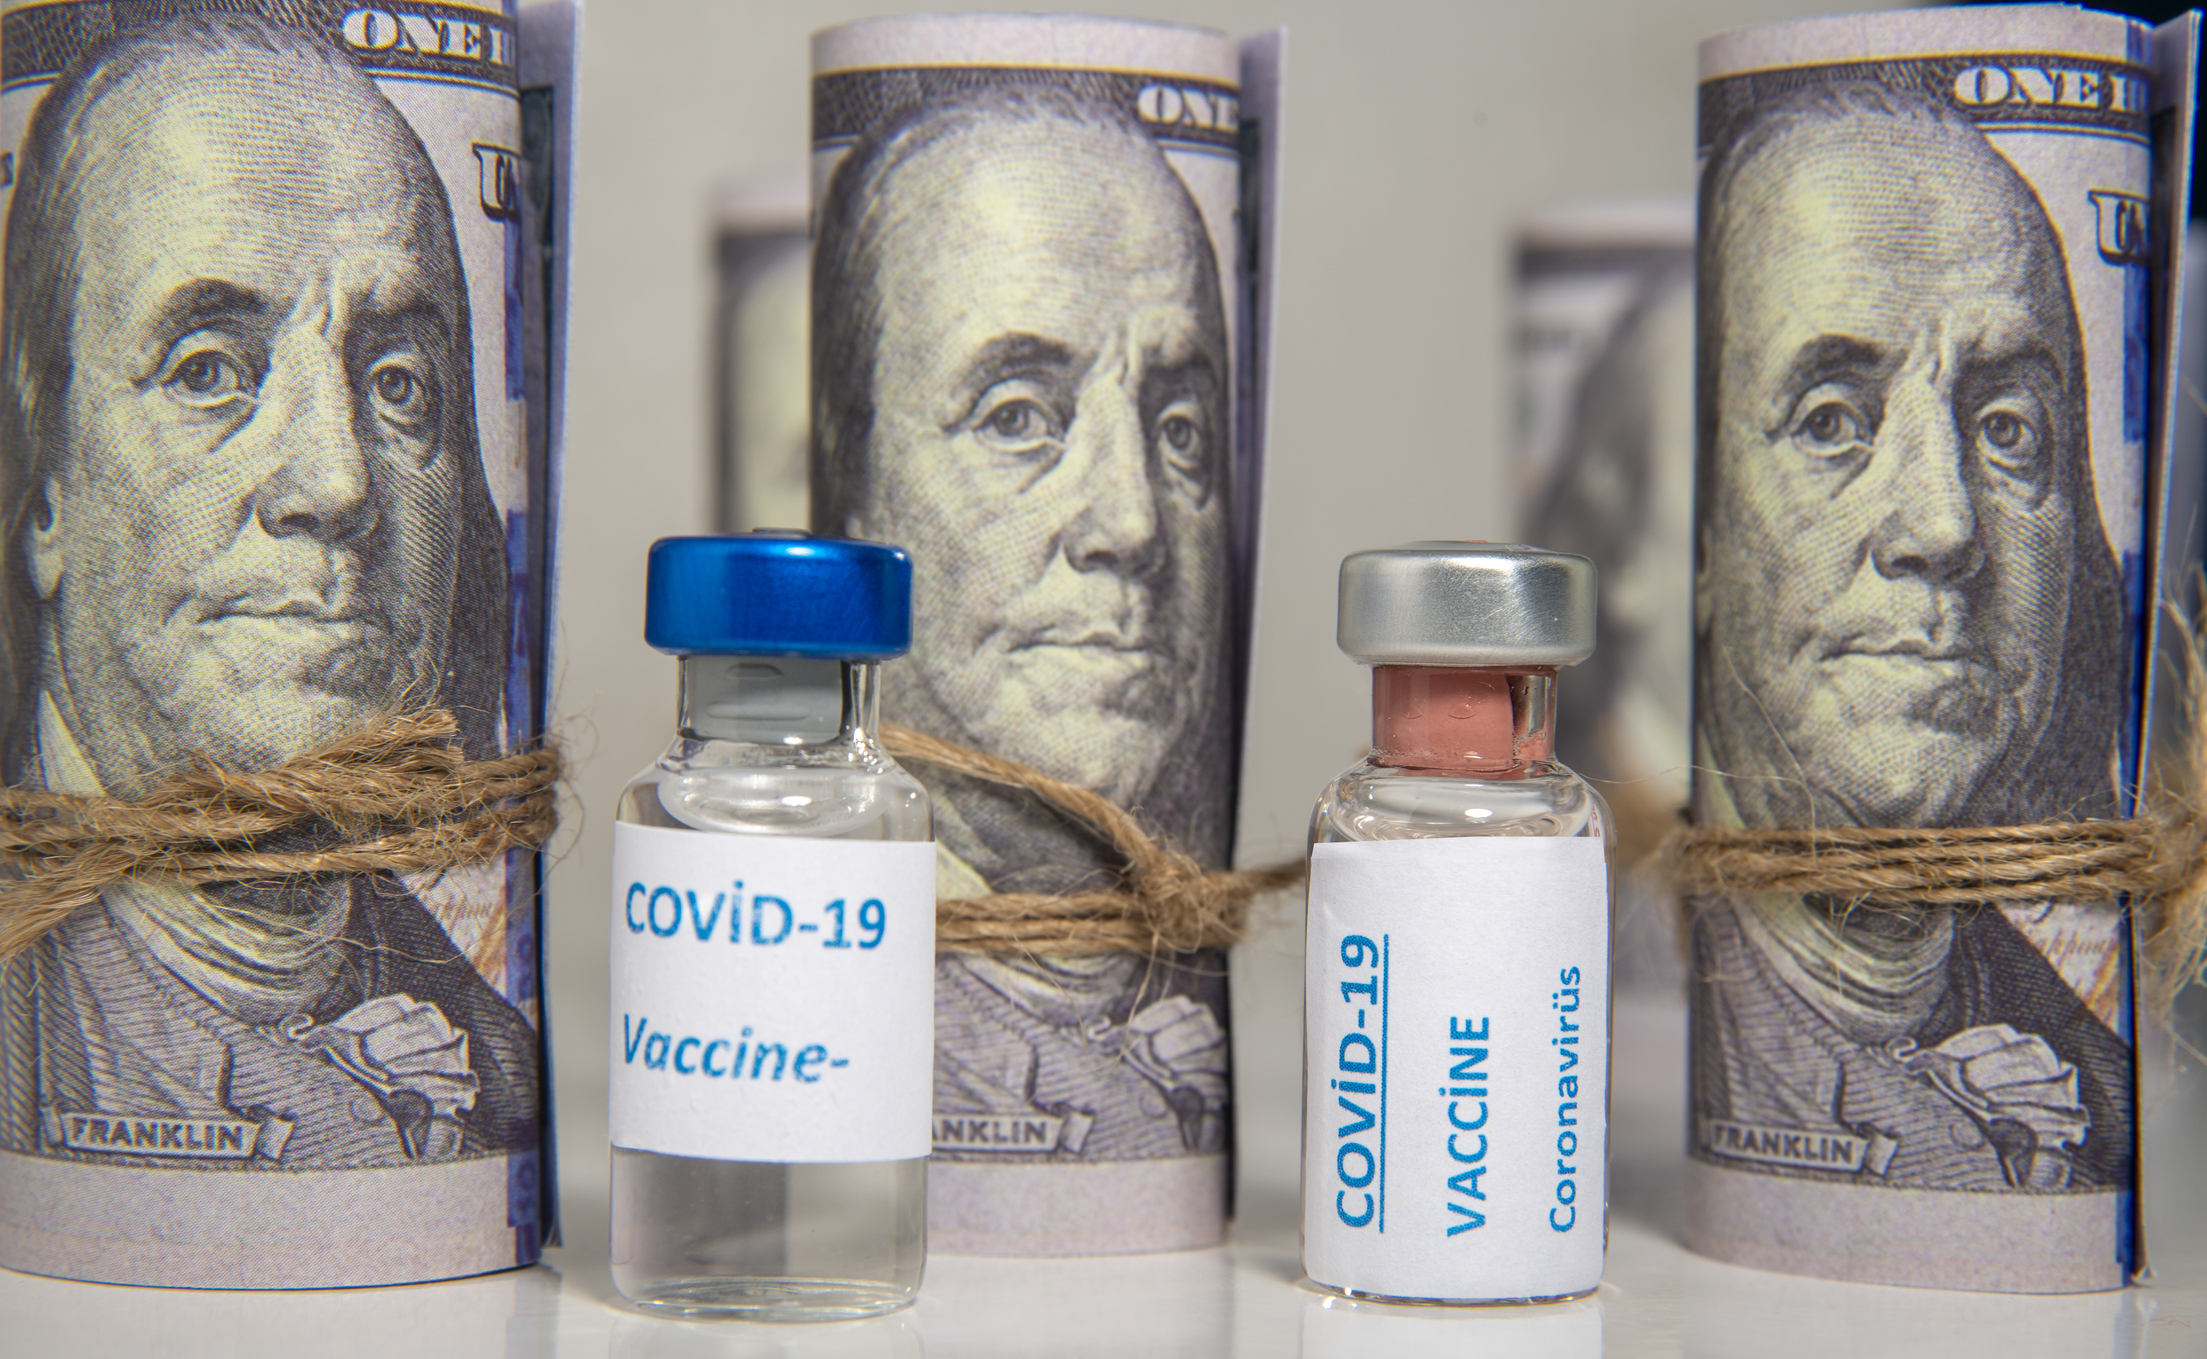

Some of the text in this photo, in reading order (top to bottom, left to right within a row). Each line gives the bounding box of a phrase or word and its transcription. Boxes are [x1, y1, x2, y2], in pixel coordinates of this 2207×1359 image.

[623, 1012, 850, 1083] Vaccine-
[1549, 965, 1581, 1233] Coronavirüs
[71, 1116, 244, 1151] FRANKLIN
[931, 1118, 1047, 1145] NKLIN
[1714, 1122, 1855, 1164] FRANKLIN
